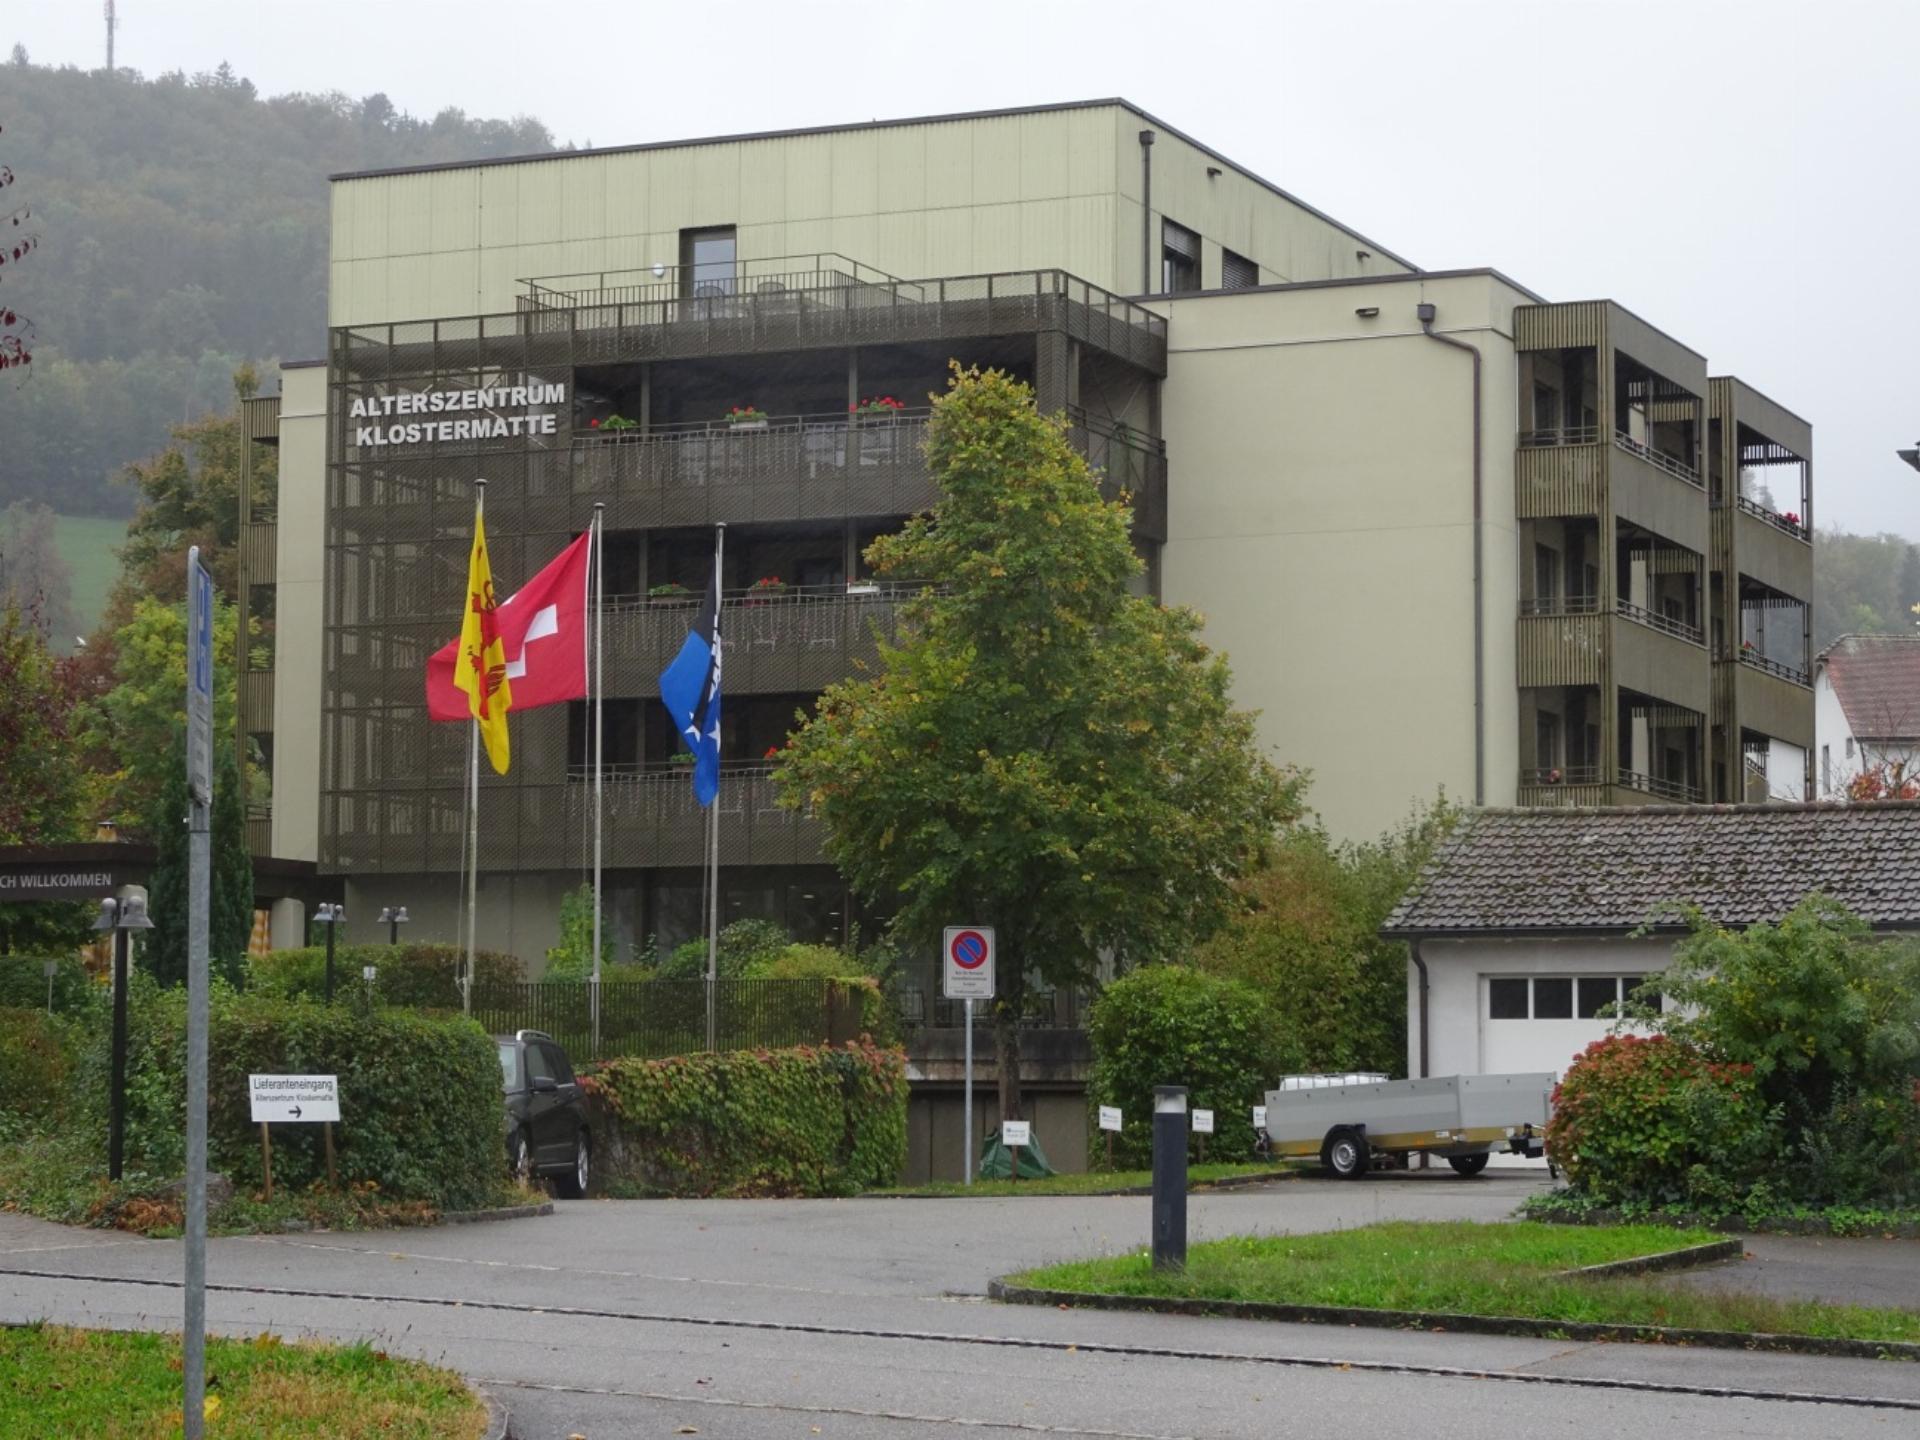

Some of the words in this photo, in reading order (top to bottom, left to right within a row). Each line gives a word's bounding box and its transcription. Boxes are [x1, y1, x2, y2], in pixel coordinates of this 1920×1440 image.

[350, 384, 565, 418] ALTERSZENTRUM
[356, 414, 558, 446] KLOSTERMATTE
[20, 873, 112, 888] WILLKOMMEN
[254, 1078, 333, 1092] Lieferanteneingang
